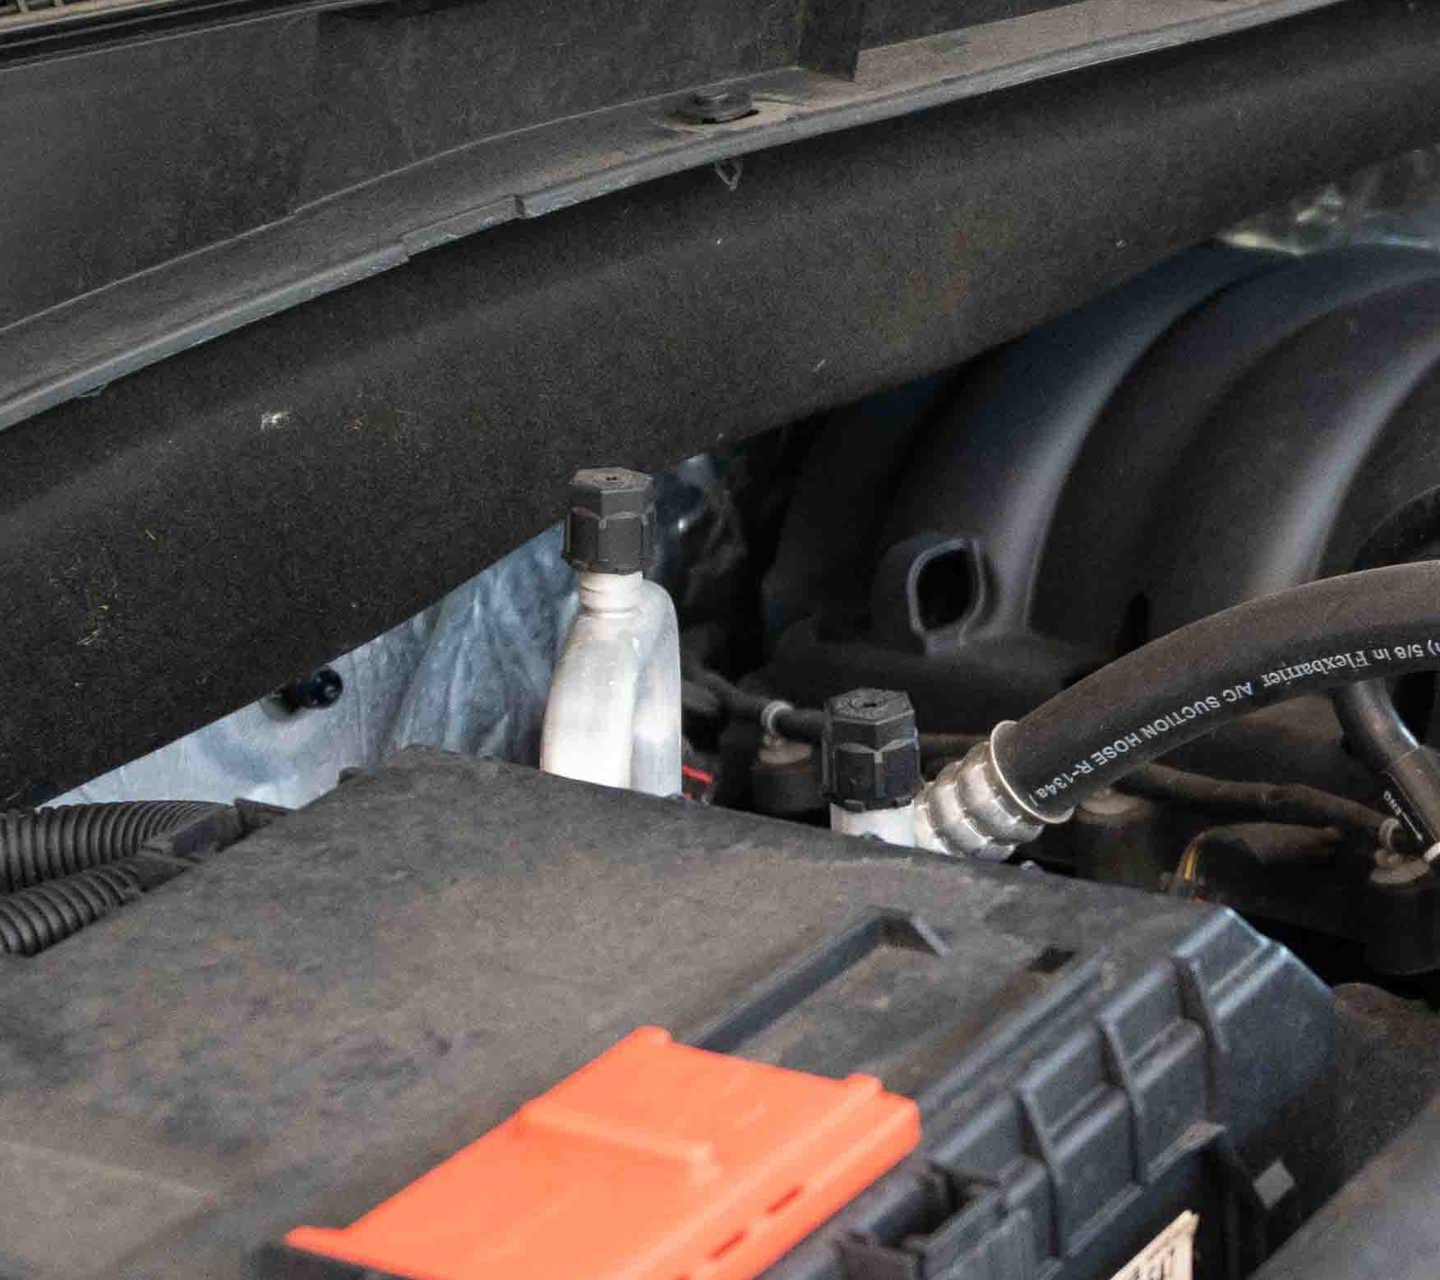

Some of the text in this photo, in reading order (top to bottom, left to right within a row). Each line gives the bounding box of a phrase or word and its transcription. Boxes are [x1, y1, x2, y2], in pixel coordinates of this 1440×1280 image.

[1373, 647, 1392, 661] in
[1393, 644, 1425, 659] 5/8
[1261, 650, 1373, 688] Flexbarrier
[1222, 681, 1255, 703] A/C
[1139, 695, 1222, 740] SUCTION
[1090, 732, 1143, 766] HOSE
[1035, 760, 1096, 799] R-134a
